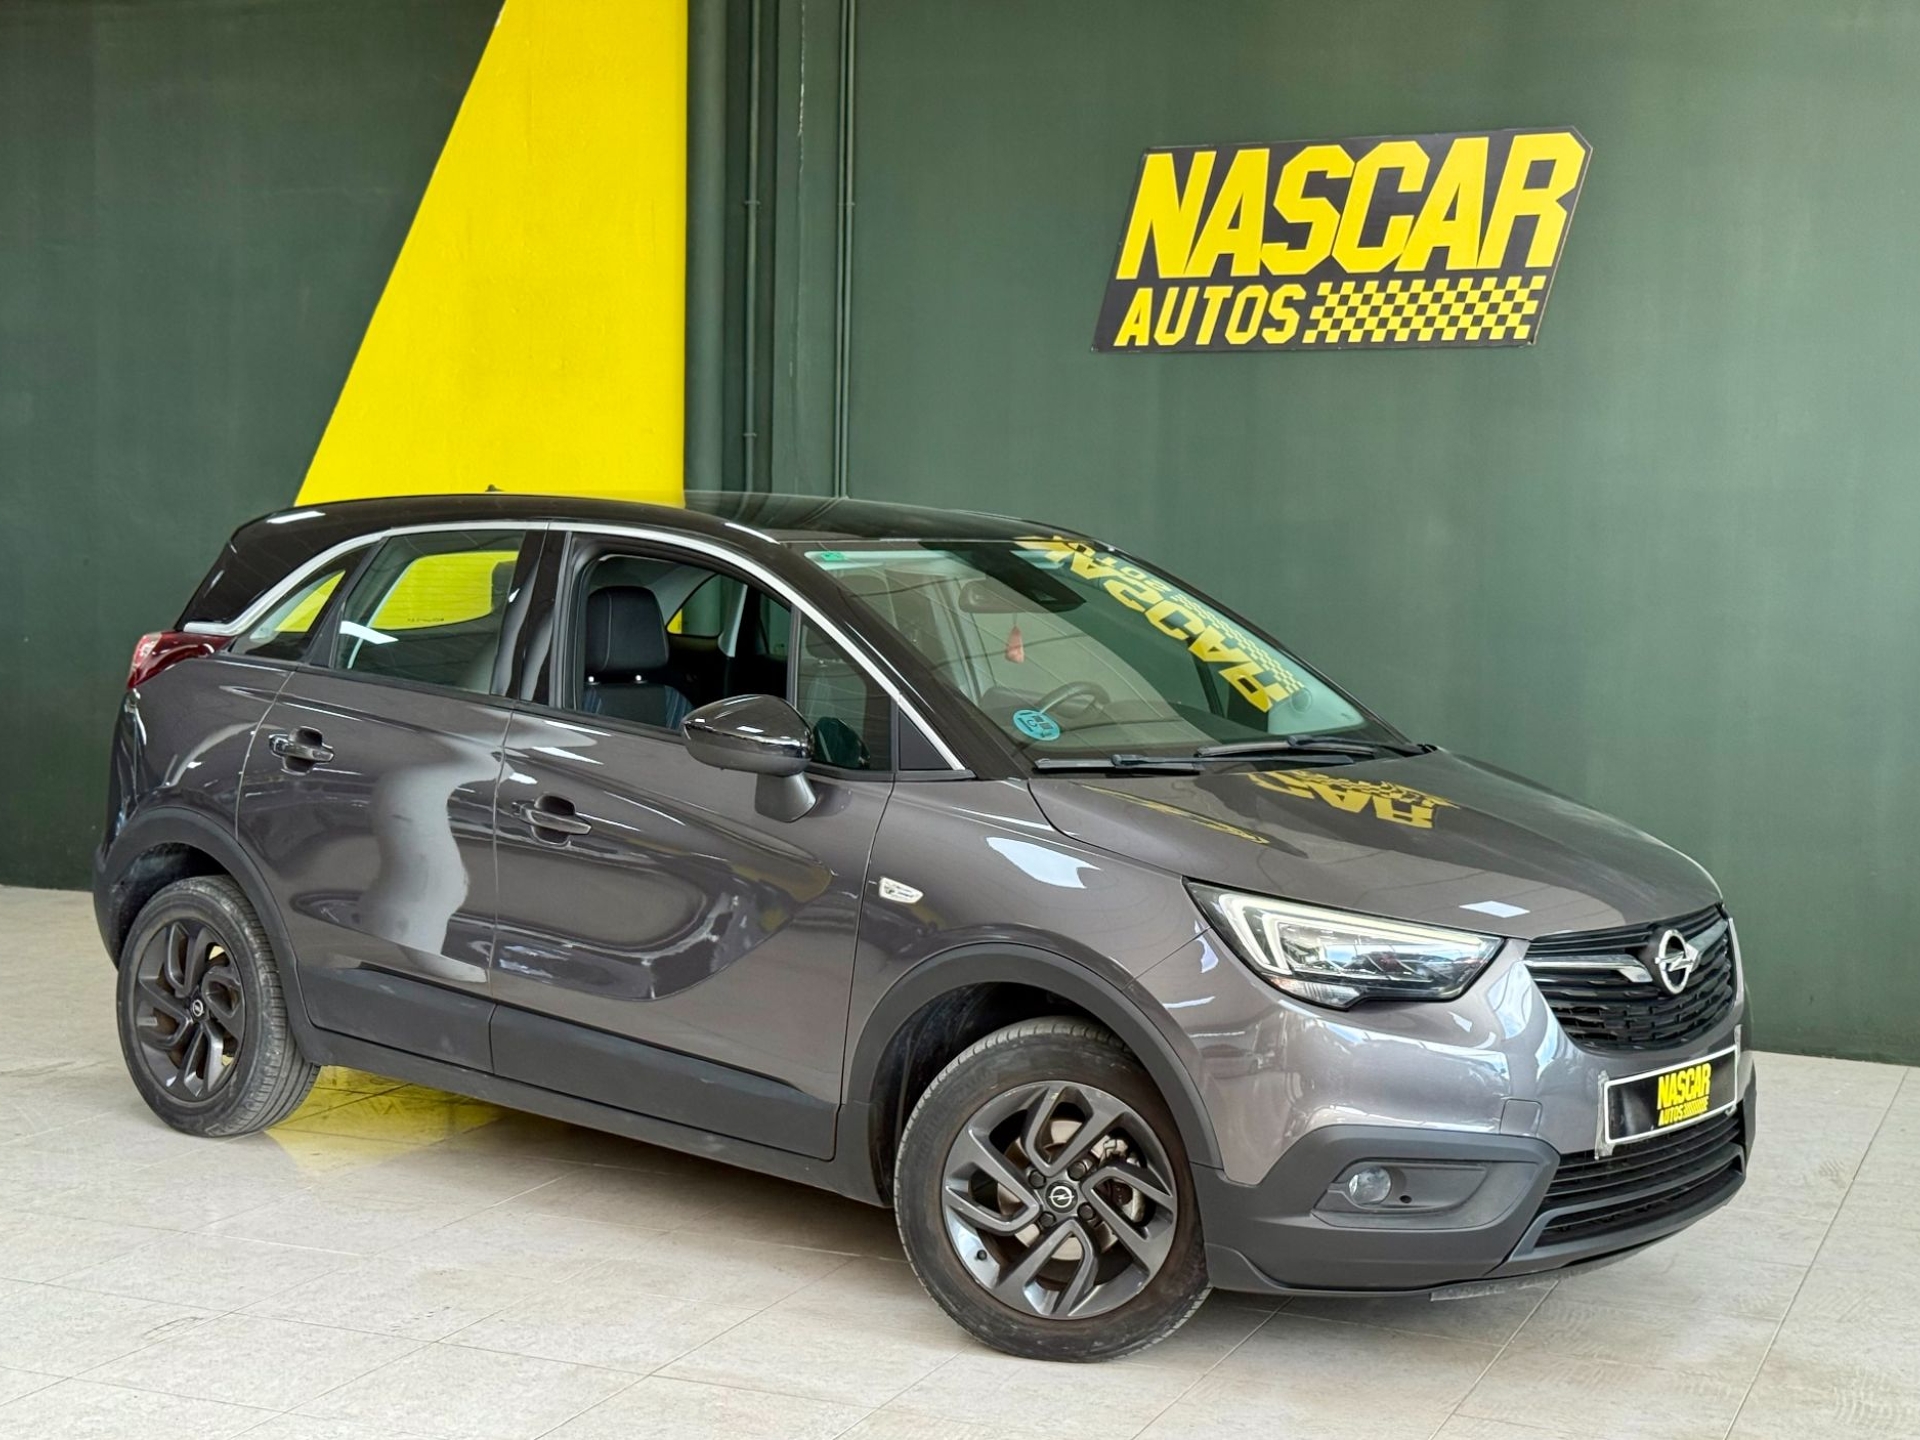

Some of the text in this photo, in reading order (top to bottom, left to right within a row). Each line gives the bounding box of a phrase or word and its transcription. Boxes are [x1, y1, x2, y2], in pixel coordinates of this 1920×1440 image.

[1115, 132, 1586, 280] NASCAR
[1113, 283, 1307, 347] AUTOS
[1657, 1062, 1711, 1110] NASCAR
[1658, 1104, 1684, 1127] AUTOS
